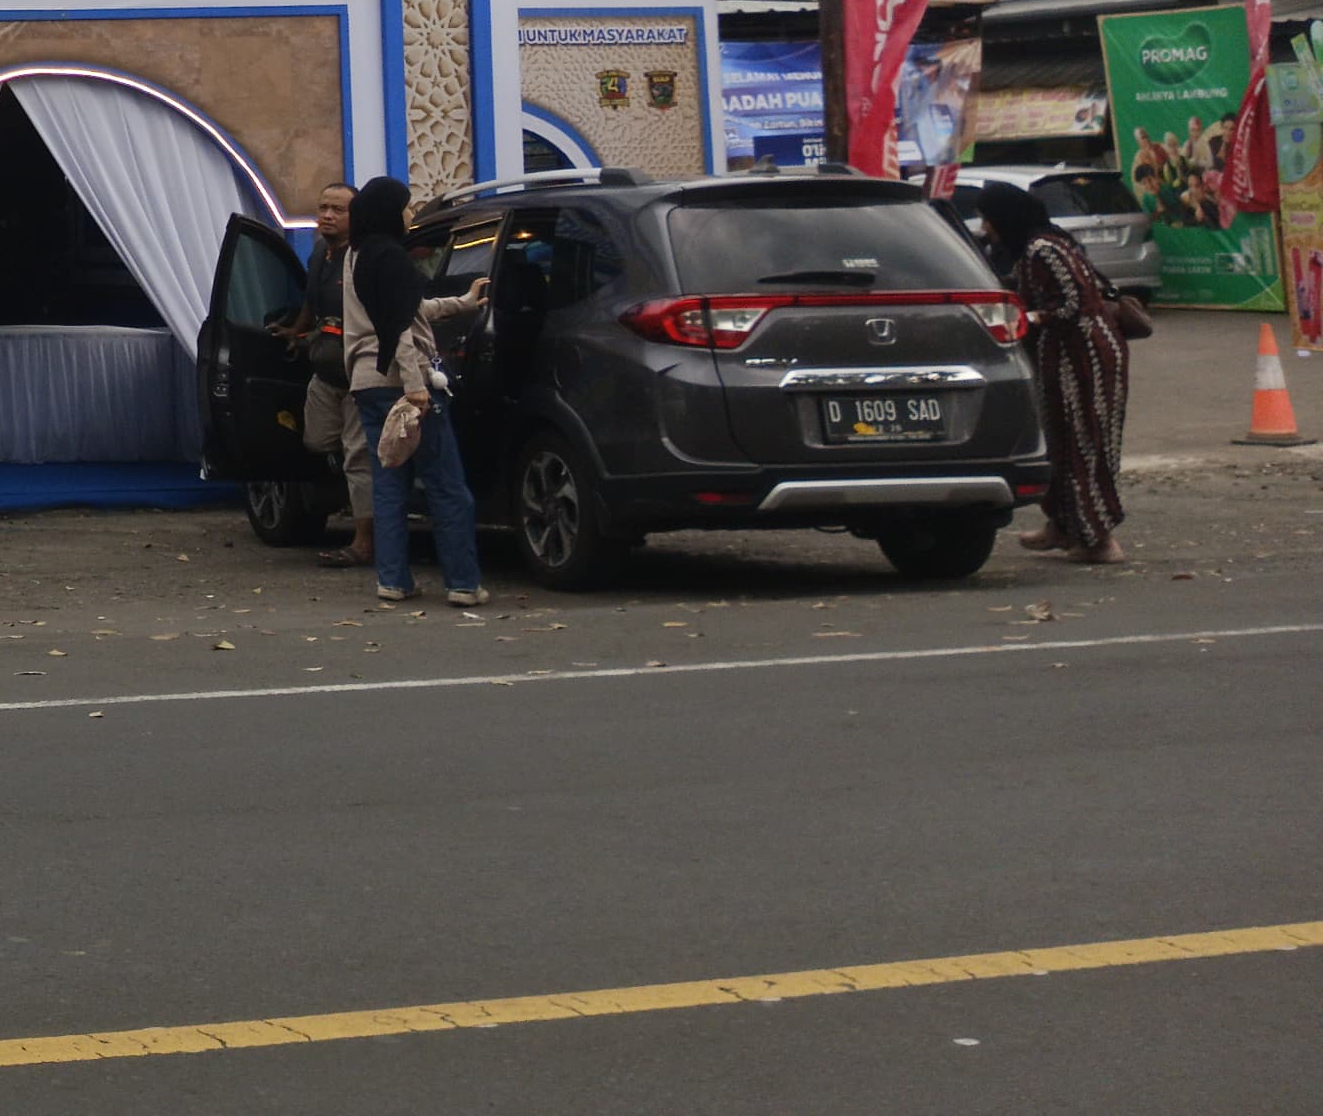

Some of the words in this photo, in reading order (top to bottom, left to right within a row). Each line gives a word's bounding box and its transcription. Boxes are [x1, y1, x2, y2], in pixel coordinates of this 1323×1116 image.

[525, 28, 580, 43] UNTUK
[583, 27, 685, 43] MASYARAKAT
[1142, 46, 1208, 65] PROMAG
[828, 401, 841, 423] D
[856, 400, 896, 422] 1609
[907, 399, 941, 421] SAD
